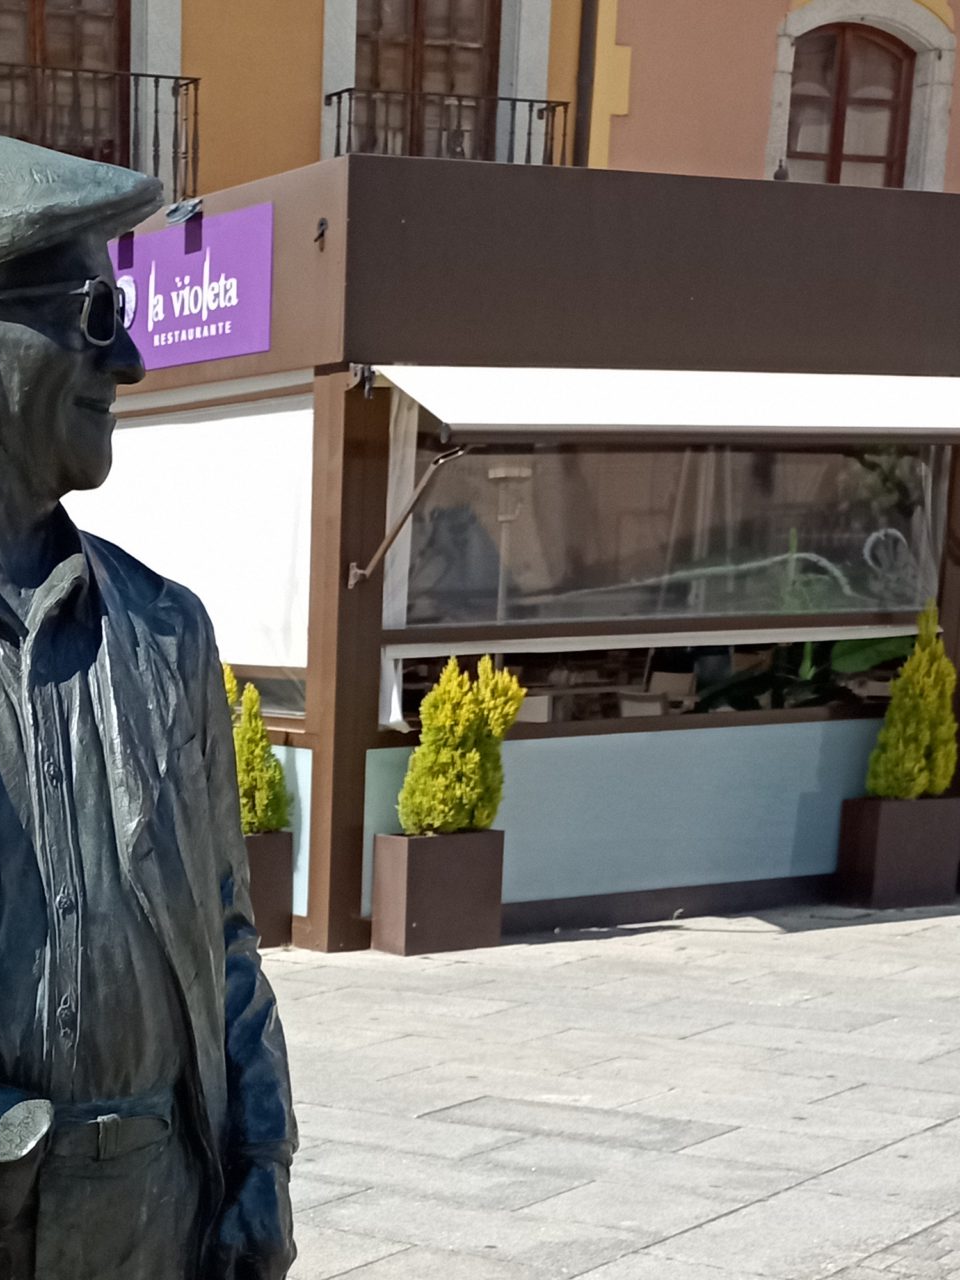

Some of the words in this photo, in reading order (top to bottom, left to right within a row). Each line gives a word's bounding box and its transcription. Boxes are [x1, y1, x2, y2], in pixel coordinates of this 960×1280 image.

[147, 260, 165, 332] la
[170, 246, 239, 321] violeta
[153, 321, 232, 347] RESTAURANTE
